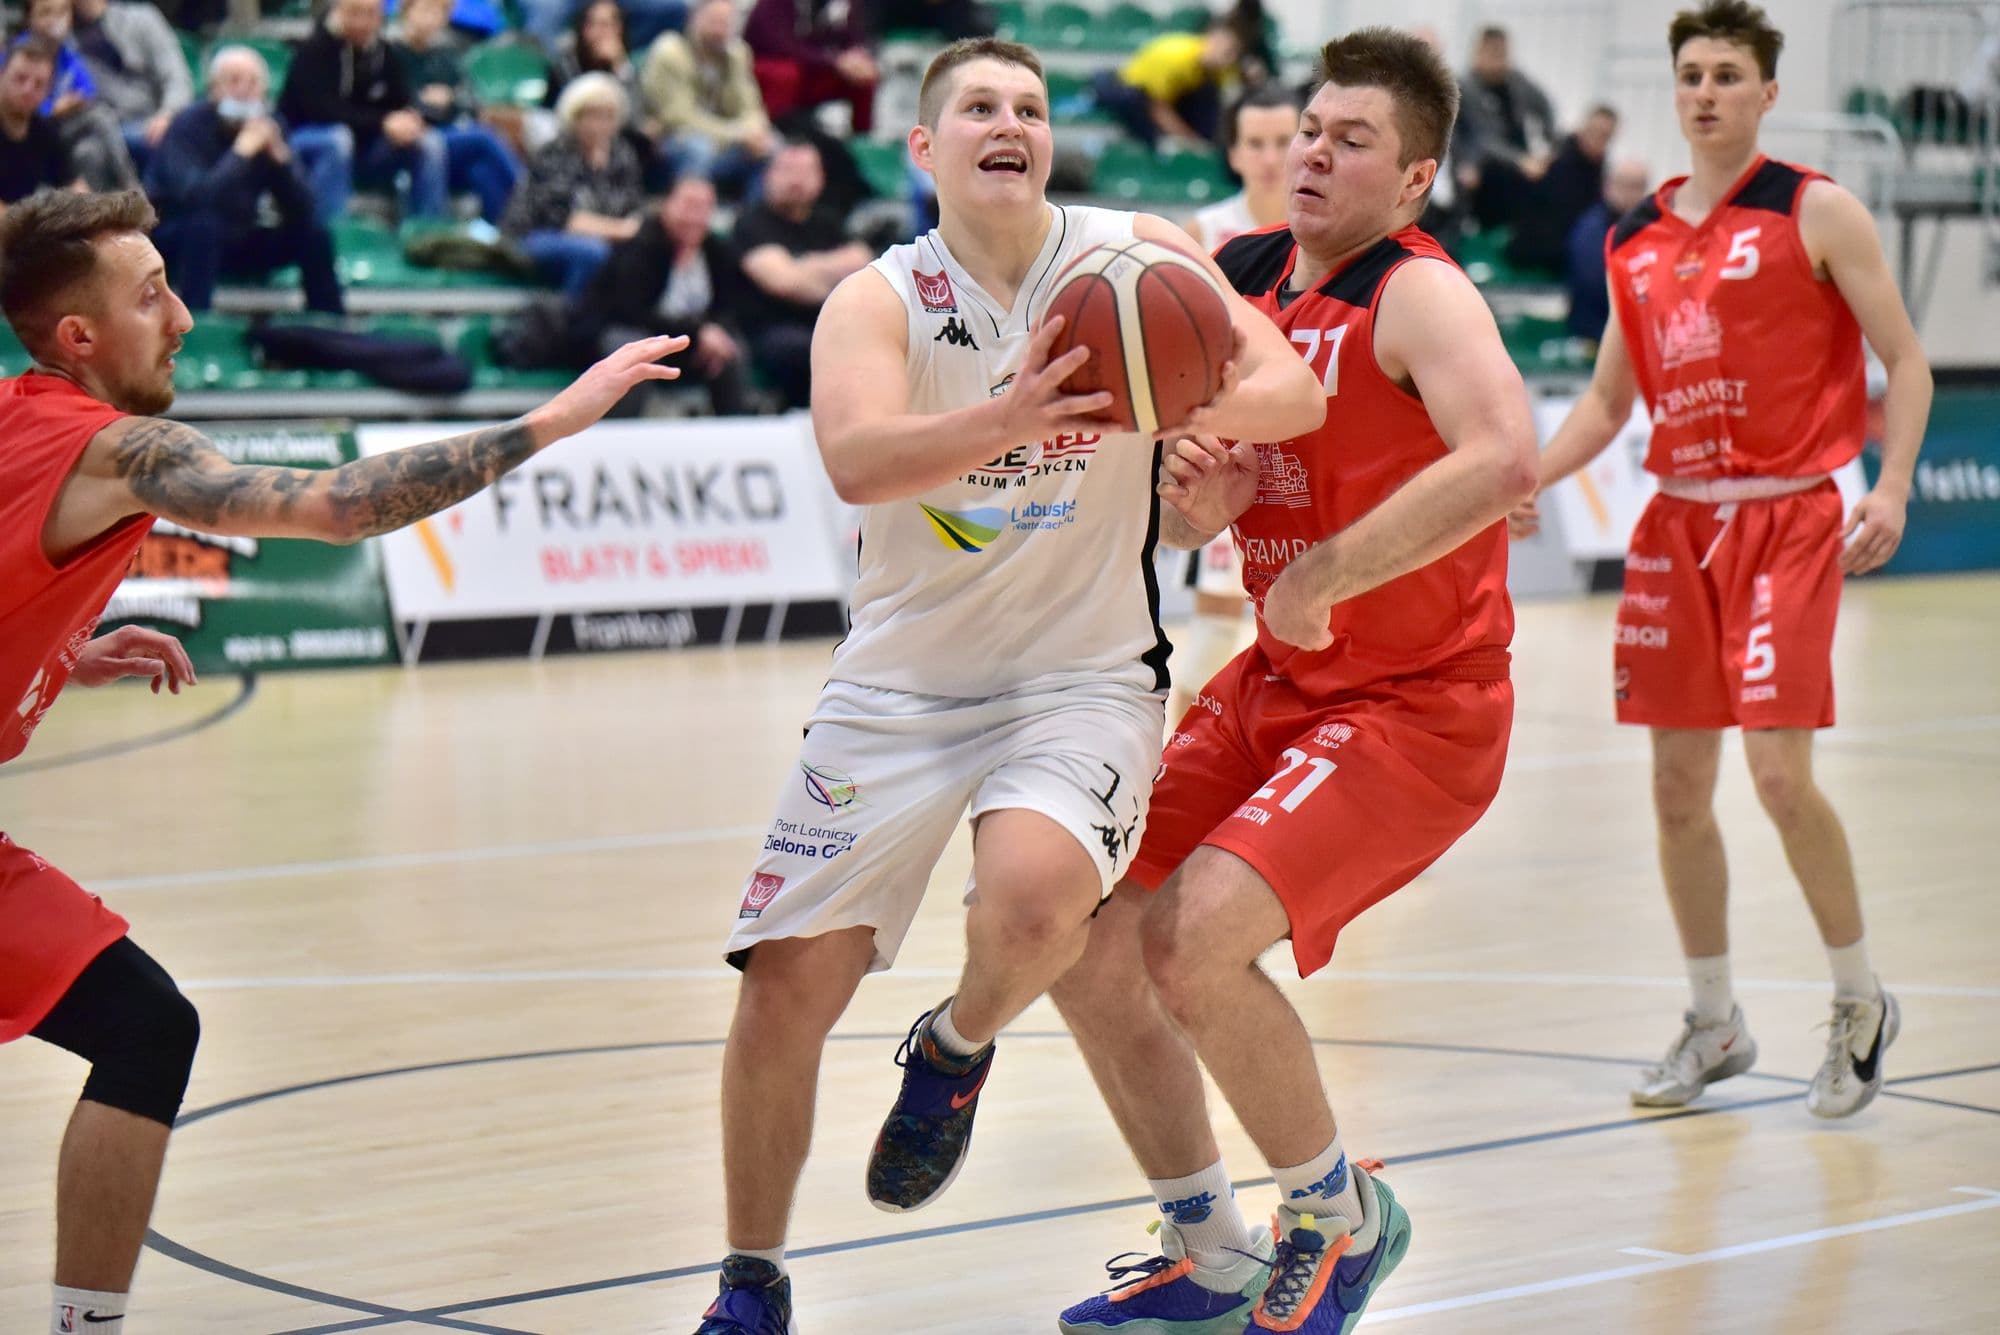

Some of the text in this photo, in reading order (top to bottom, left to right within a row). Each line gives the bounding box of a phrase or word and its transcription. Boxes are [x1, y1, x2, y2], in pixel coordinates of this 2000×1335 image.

[1719, 227, 1762, 280] 5
[490, 457, 788, 532] FRANKO
[959, 473, 1008, 490] RUM
[540, 544, 640, 585] BLATY
[649, 543, 672, 576] &
[1742, 620, 1776, 682] 5
[1248, 747, 1338, 814] 21
[764, 834, 817, 858] Zielona
[775, 818, 858, 845] Port Lotniczy
